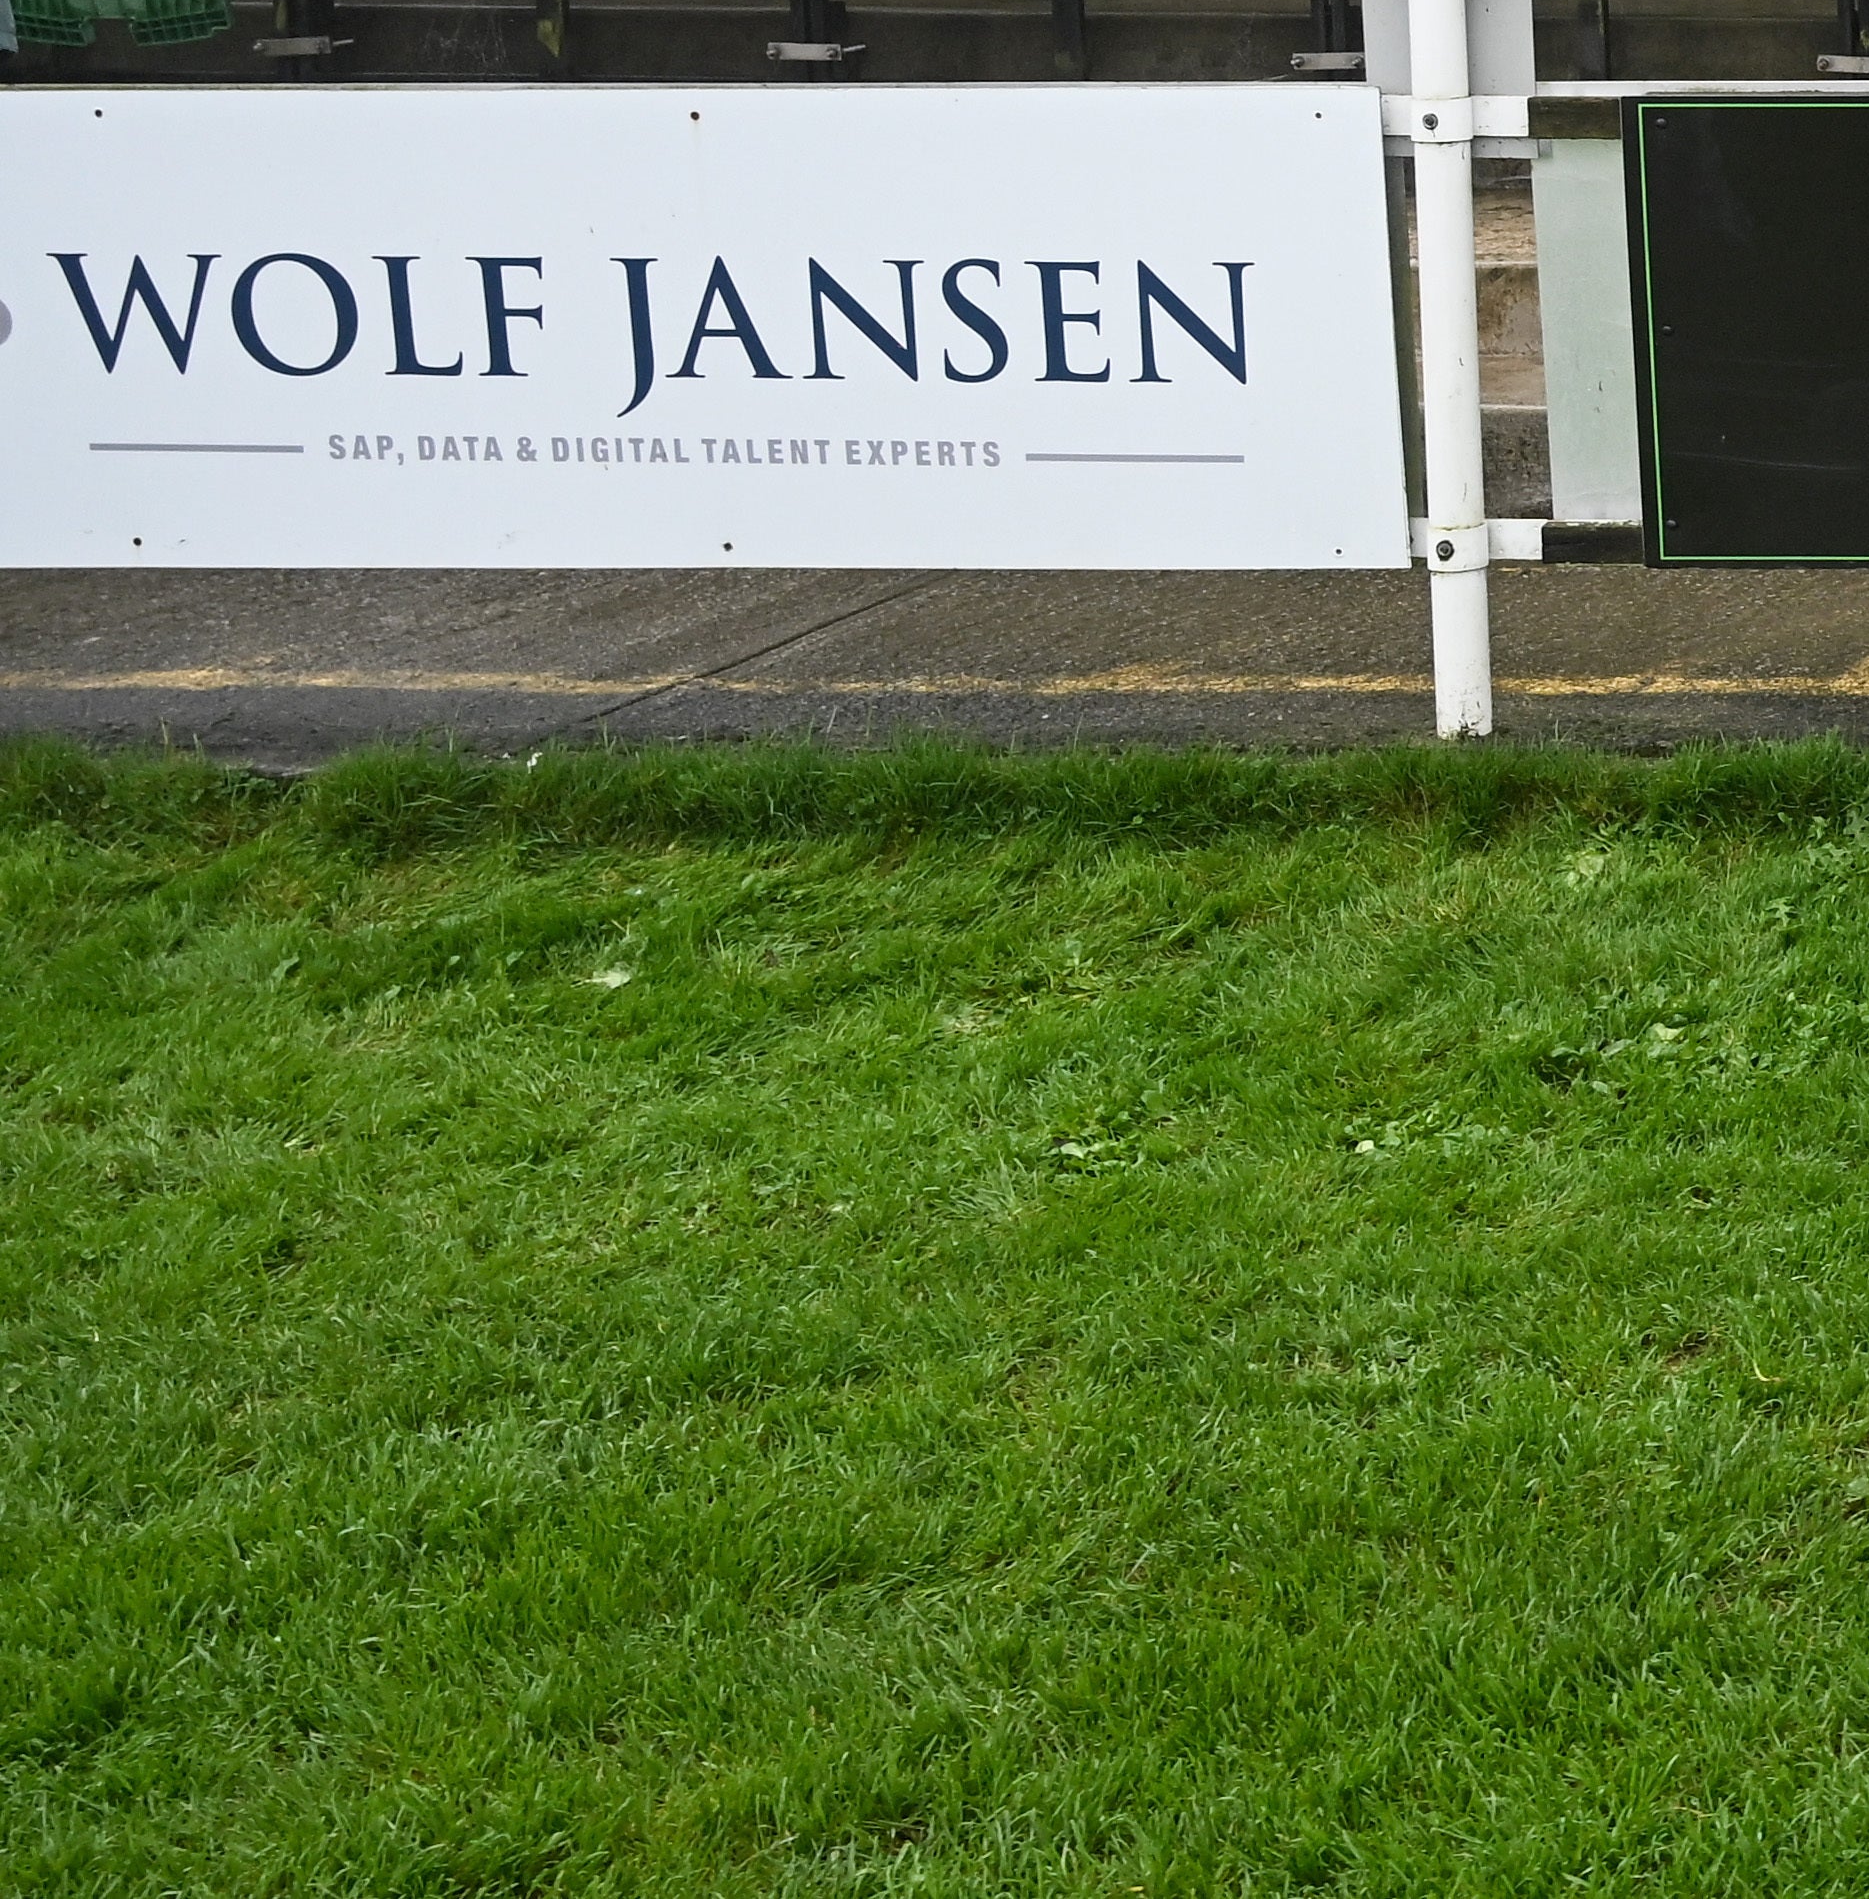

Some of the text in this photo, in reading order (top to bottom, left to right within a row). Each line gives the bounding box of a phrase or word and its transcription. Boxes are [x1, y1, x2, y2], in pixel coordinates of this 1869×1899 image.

[46, 253, 1254, 418] WOLF JANSEN
[328, 433, 1002, 468] SAP, DATA & DIGITAL TALENT EXPERTS
